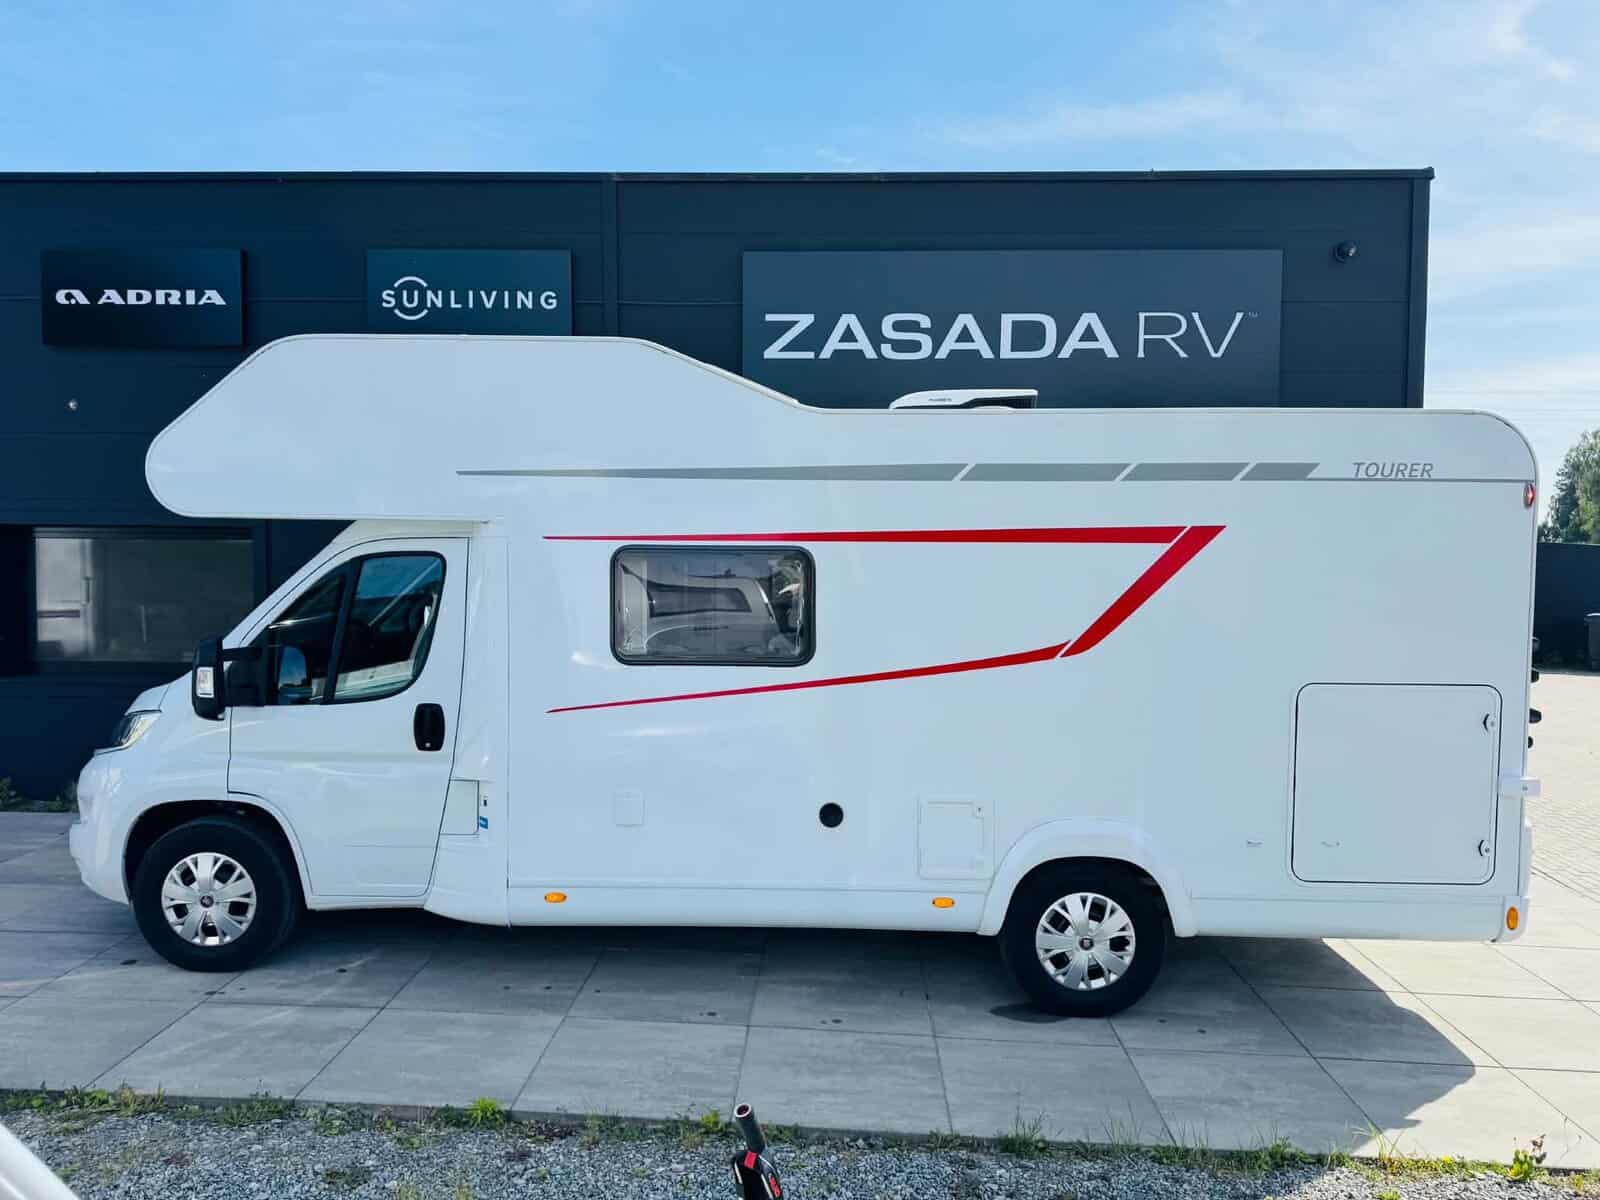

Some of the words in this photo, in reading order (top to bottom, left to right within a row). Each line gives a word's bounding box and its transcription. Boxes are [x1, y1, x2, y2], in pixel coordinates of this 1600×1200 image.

[97, 289, 227, 305] ADRIA
[381, 288, 558, 311] SUNLIVING
[763, 312, 1120, 361] ZASADA
[1136, 311, 1244, 359] RV
[1352, 462, 1434, 479] TOURER
